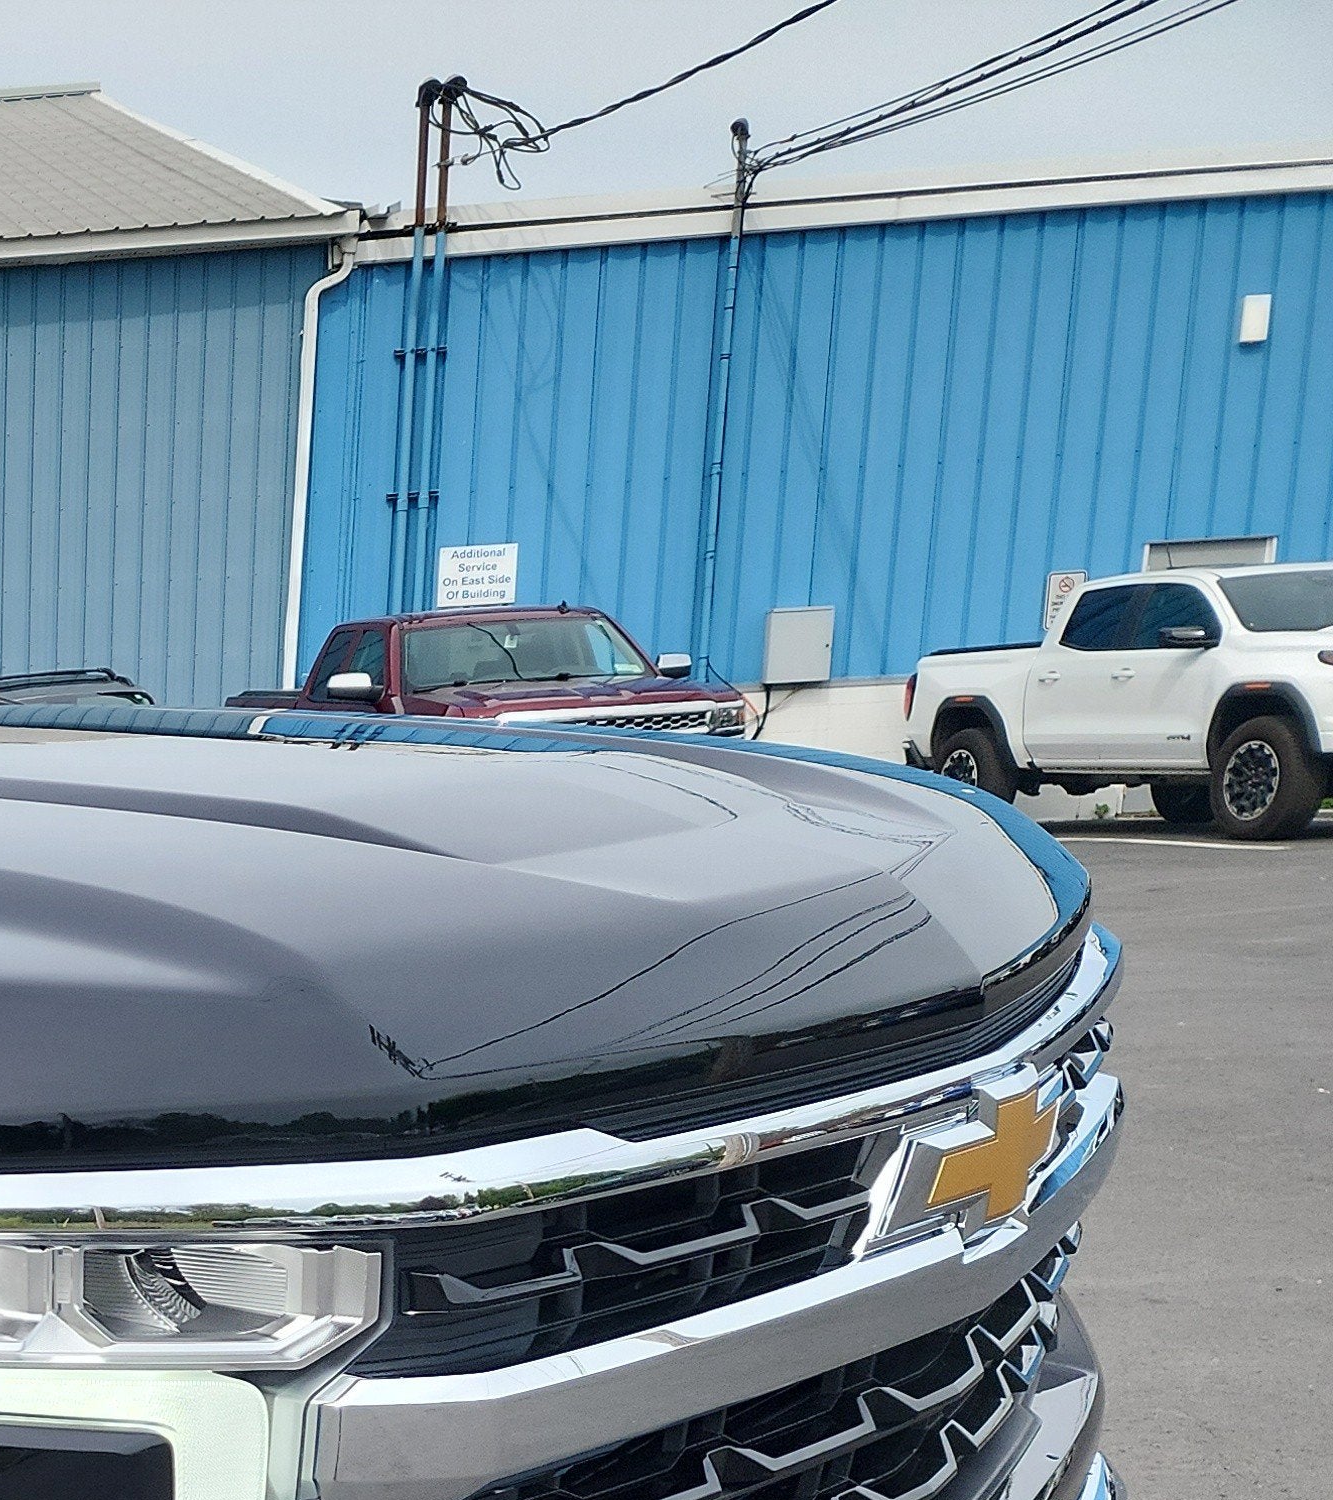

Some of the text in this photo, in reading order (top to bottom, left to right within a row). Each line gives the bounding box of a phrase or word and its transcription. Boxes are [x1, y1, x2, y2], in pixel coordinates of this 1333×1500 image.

[450, 547, 506, 559] Additional
[458, 562, 498, 573] Service
[442, 574, 512, 587] On East Side
[446, 588, 507, 600] Of Building
